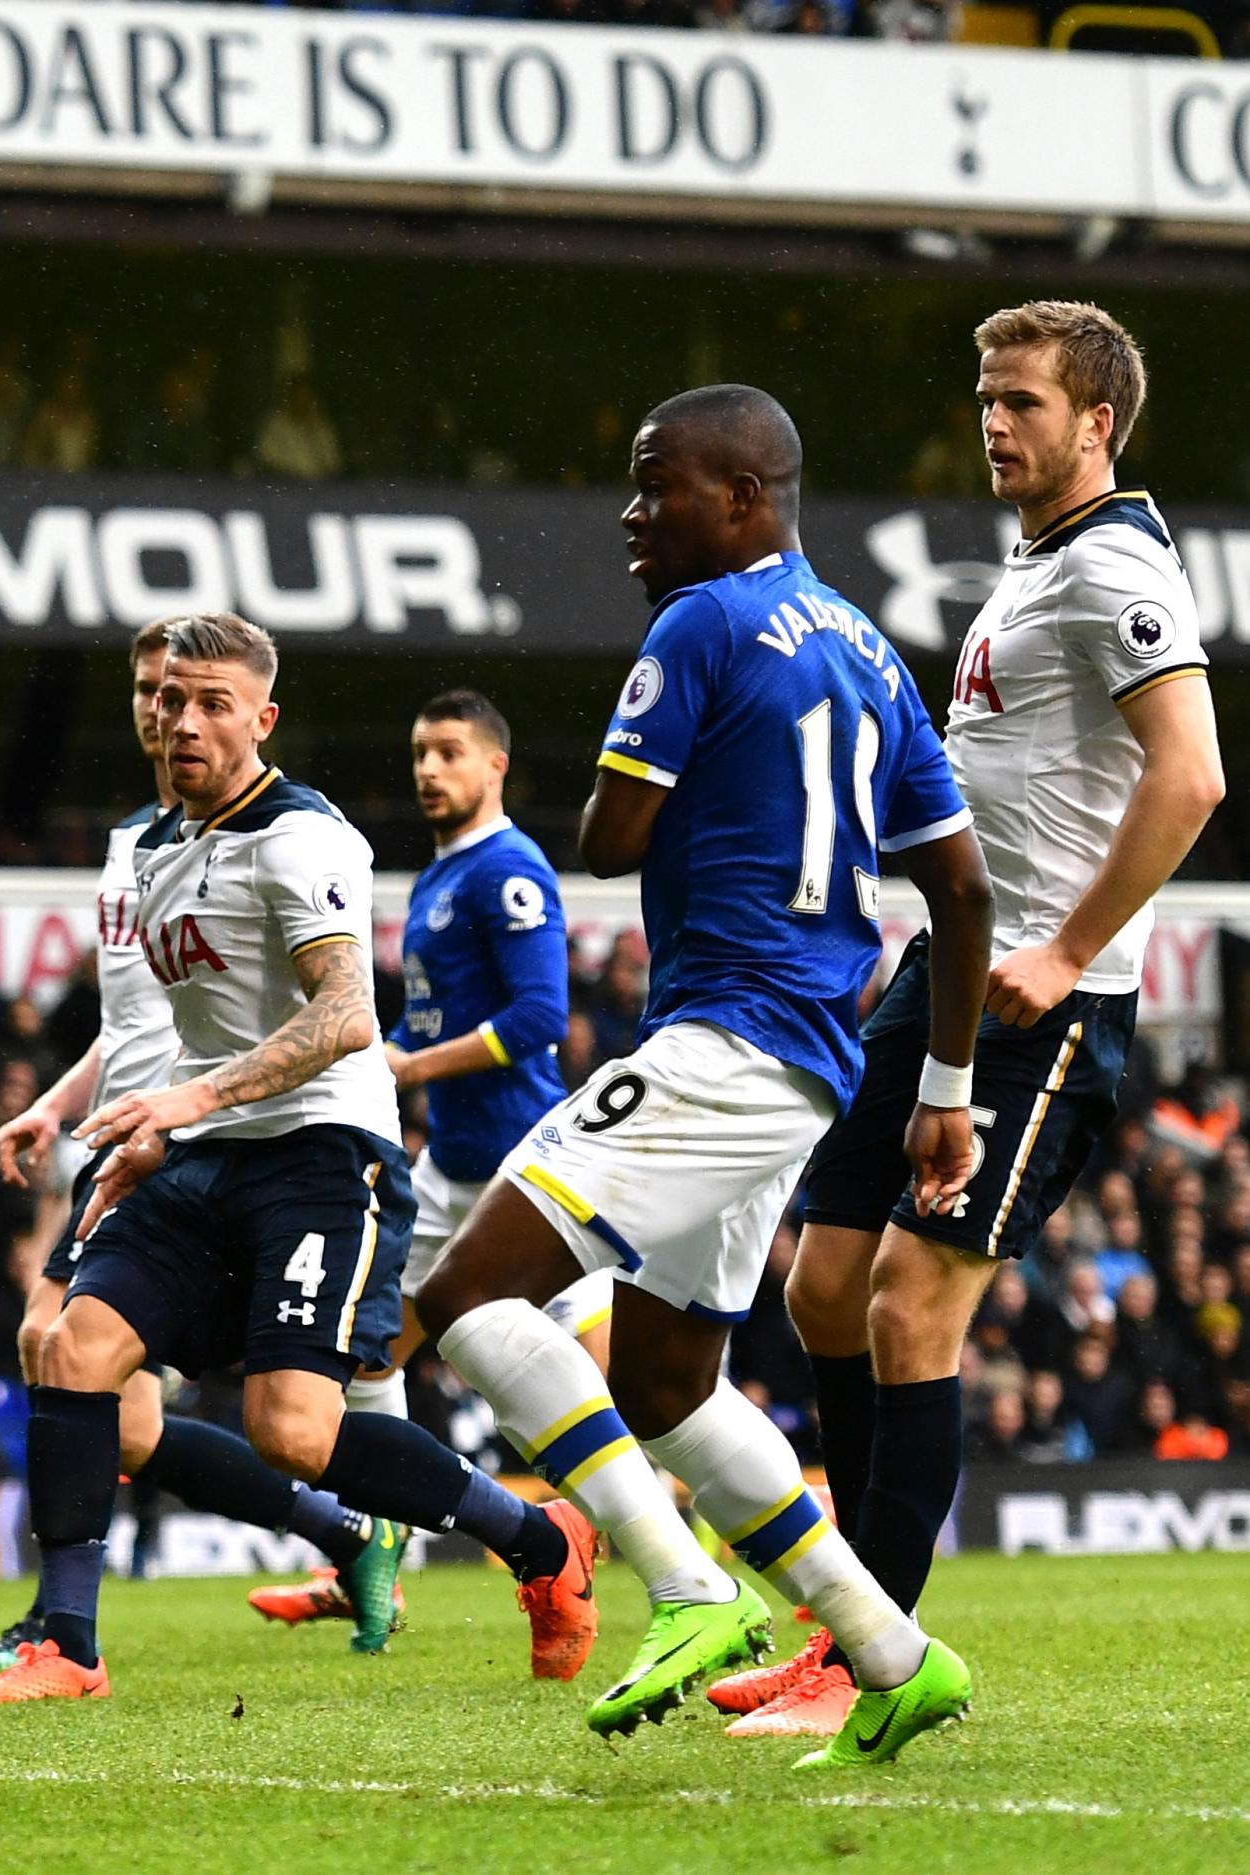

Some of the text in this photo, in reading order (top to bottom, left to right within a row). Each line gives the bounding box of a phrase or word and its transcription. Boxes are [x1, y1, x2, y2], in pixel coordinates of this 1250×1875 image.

[304, 34, 395, 156] IS
[428, 42, 572, 165] TO
[613, 50, 772, 173] DO
[1168, 80, 1250, 200] C
[283, 1231, 327, 1299] 4
